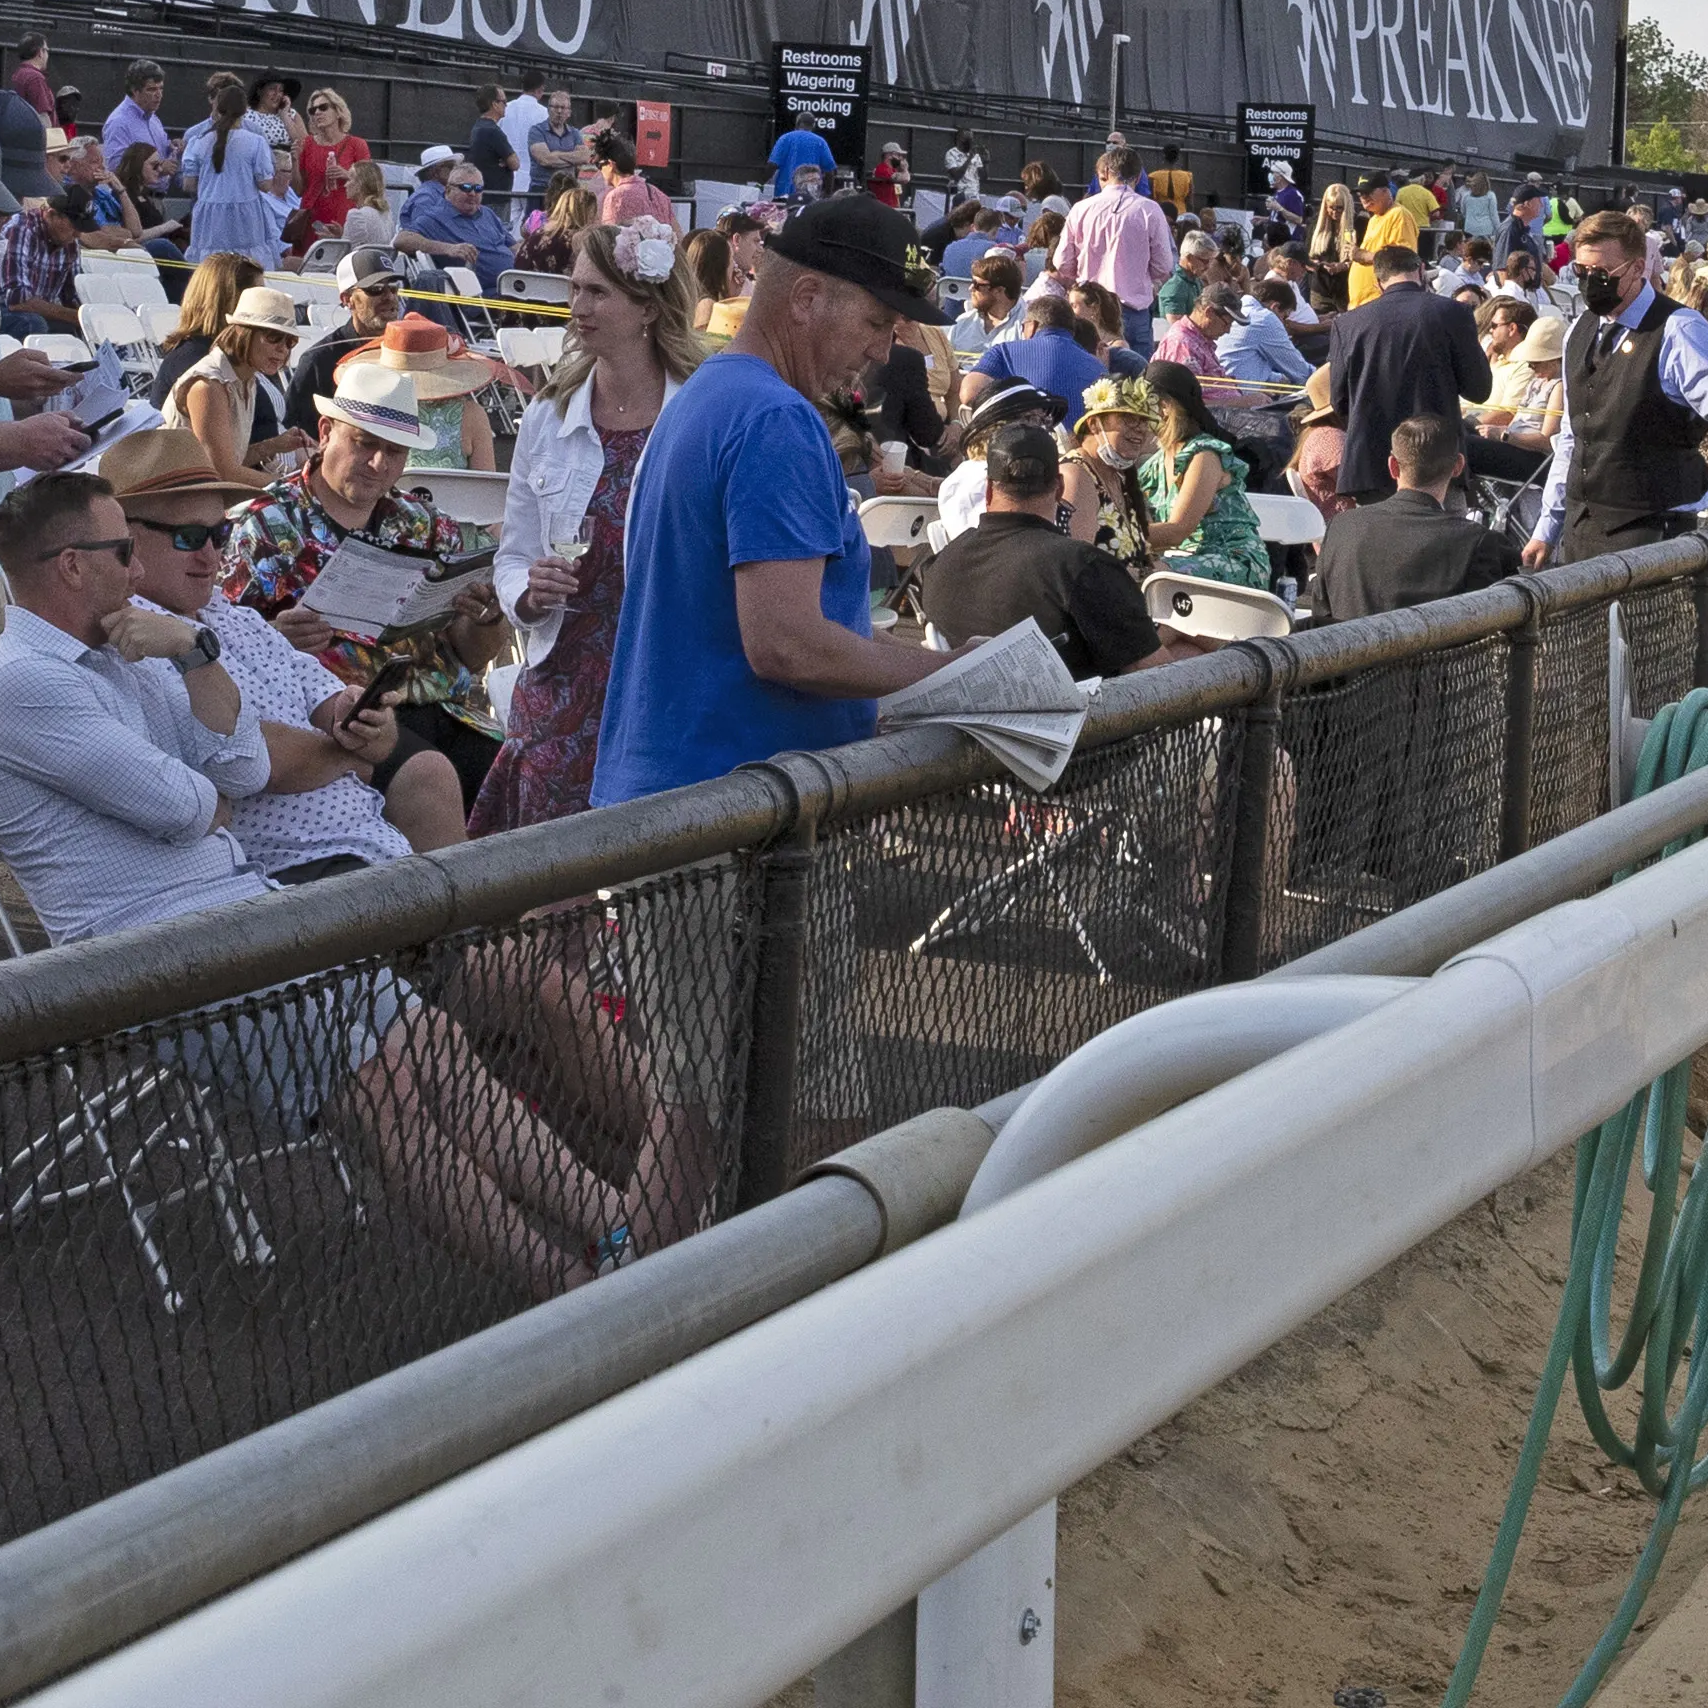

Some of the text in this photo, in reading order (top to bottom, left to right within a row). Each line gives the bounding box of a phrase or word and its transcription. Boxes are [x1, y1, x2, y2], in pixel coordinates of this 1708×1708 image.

[781, 48, 862, 67] Restrooms
[786, 71, 855, 92] Wagering
[786, 96, 852, 117] Smoking
[1245, 107, 1308, 121] Restrooms
[815, 117, 836, 130] ea
[1249, 125, 1304, 140] Wagering
[1250, 143, 1301, 159] Smoking
